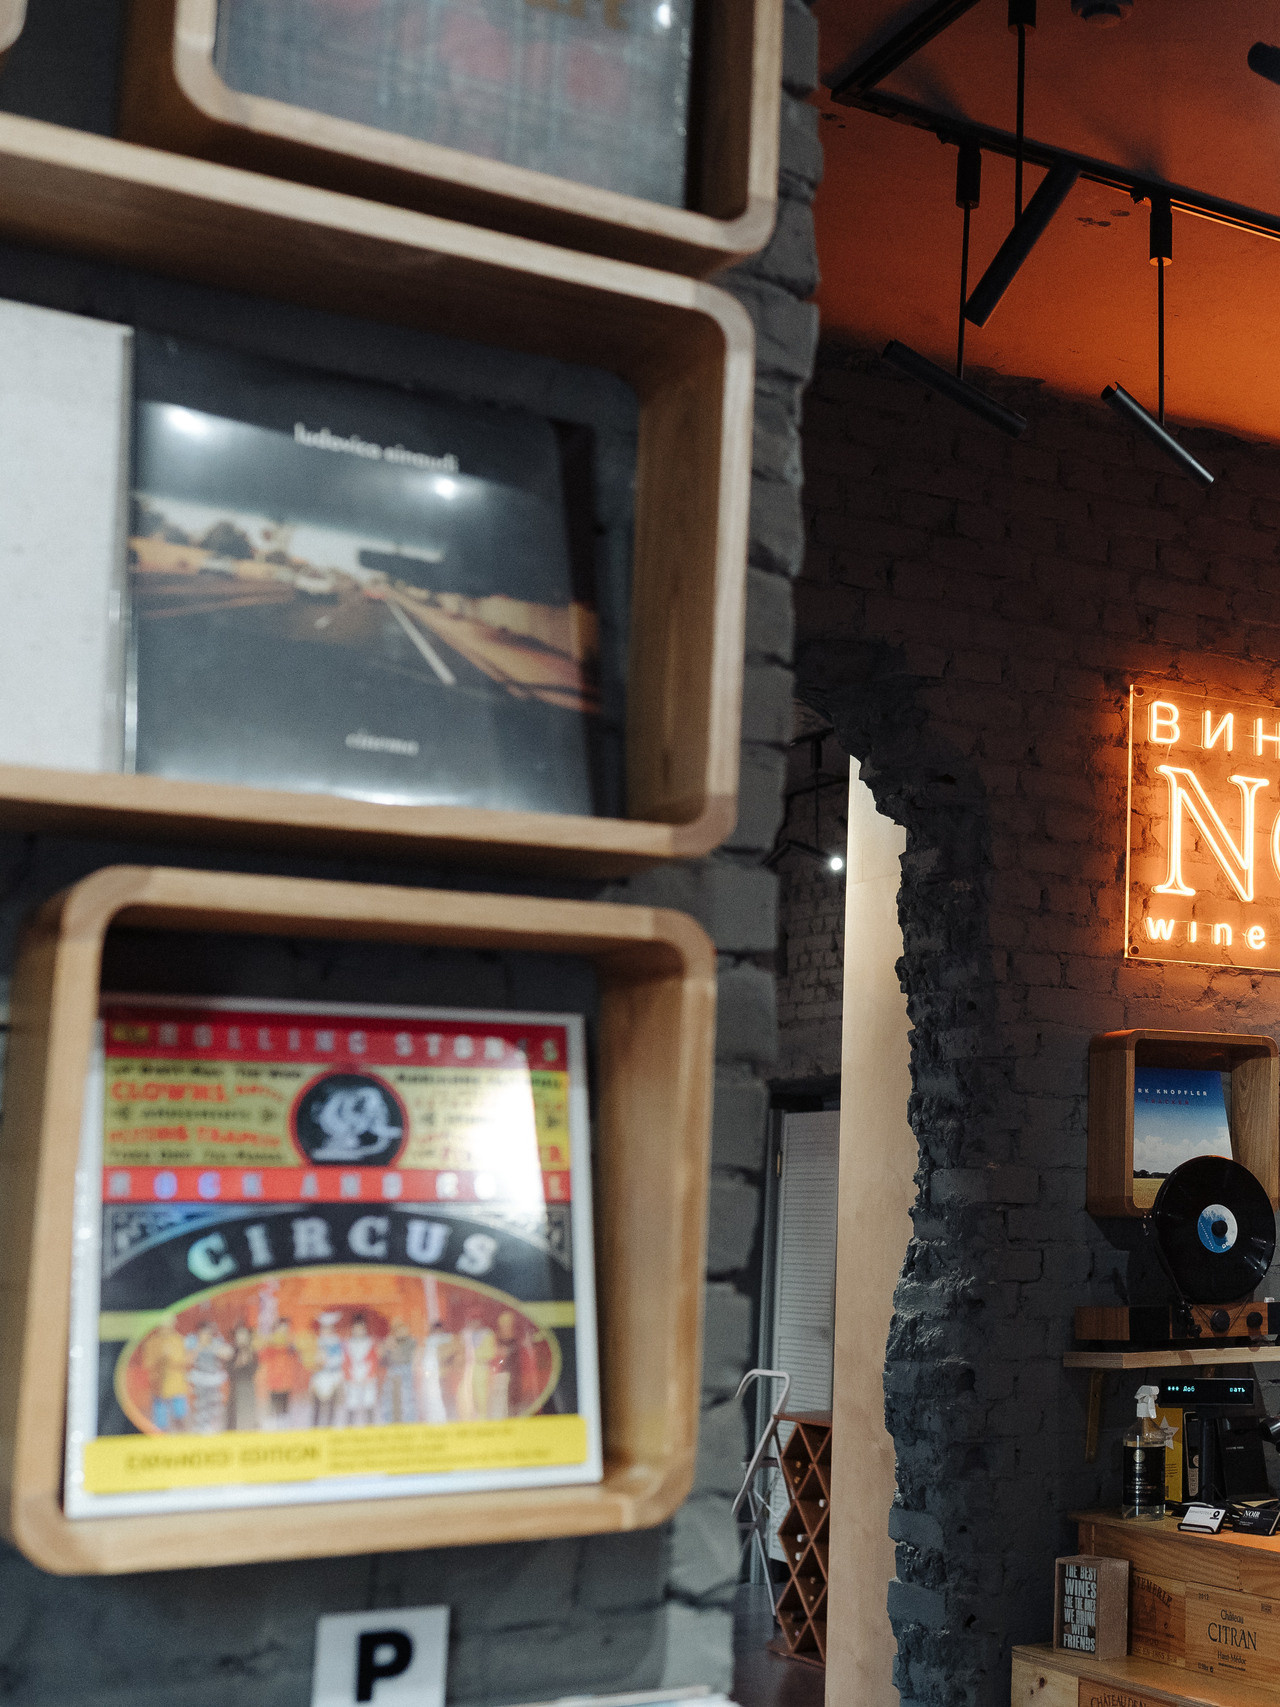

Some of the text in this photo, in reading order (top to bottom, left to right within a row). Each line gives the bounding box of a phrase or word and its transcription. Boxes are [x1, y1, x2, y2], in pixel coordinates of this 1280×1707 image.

[1145, 916, 1267, 951] wine
[187, 1215, 498, 1282] CIRCUS
[1080, 1566, 1097, 1581] BEST
[1064, 1578, 1097, 1599] WINES
[1075, 1609, 1096, 1627] DRINK
[1071, 1623, 1089, 1636] WITH
[1208, 1622, 1257, 1651] CITRAN
[1063, 1633, 1096, 1651] FRIENDS
[356, 1630, 414, 1705] P
